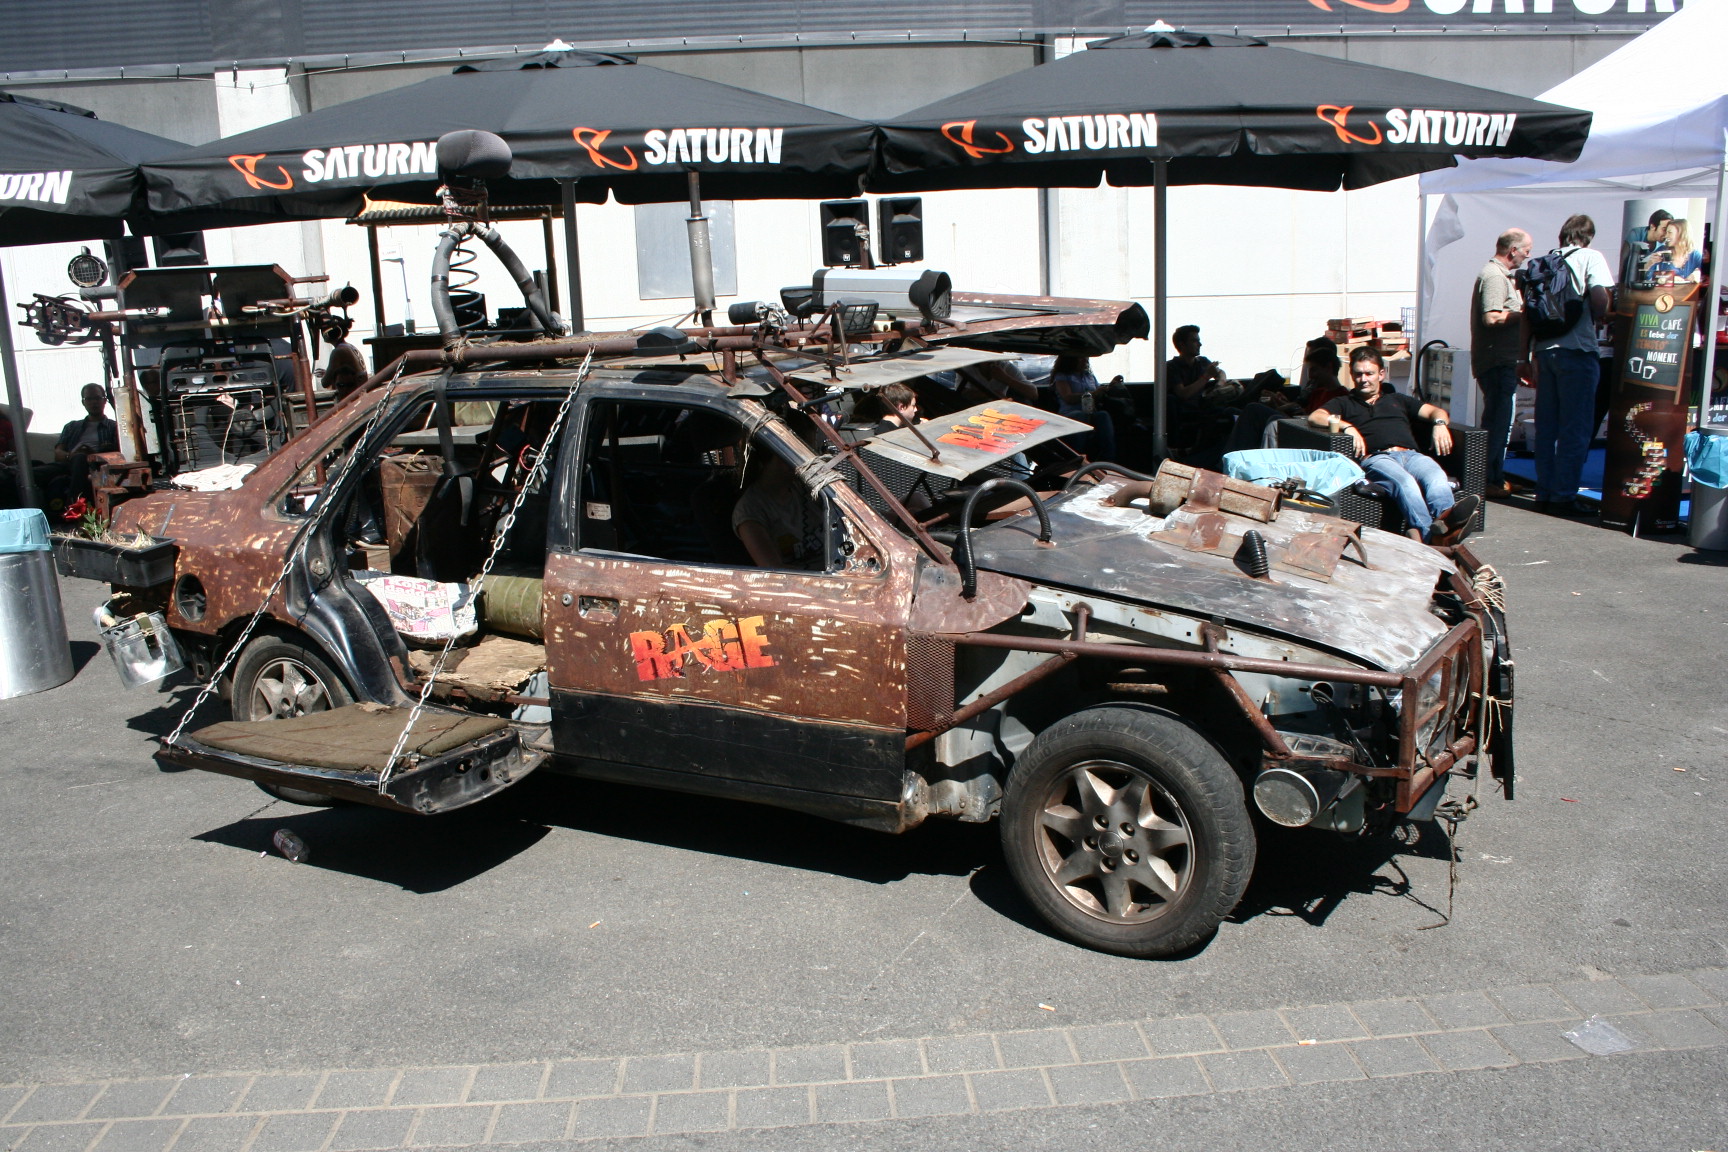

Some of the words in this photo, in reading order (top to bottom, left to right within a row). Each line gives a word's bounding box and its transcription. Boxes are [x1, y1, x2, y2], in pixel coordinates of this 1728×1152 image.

[1022, 113, 1158, 154] SATURN
[1385, 108, 1517, 147] SATURN
[301, 141, 438, 184] SATURN
[643, 128, 784, 165] SATURN
[0, 170, 73, 205] URN
[1639, 313, 1659, 326] VIVA
[1649, 330, 1666, 339] lebe
[1666, 331, 1679, 340] der
[1645, 350, 1679, 364] MOMENT.
[936, 409, 1047, 455] RAGE
[1712, 412, 1727, 423] der
[629, 615, 775, 682] RAGE
